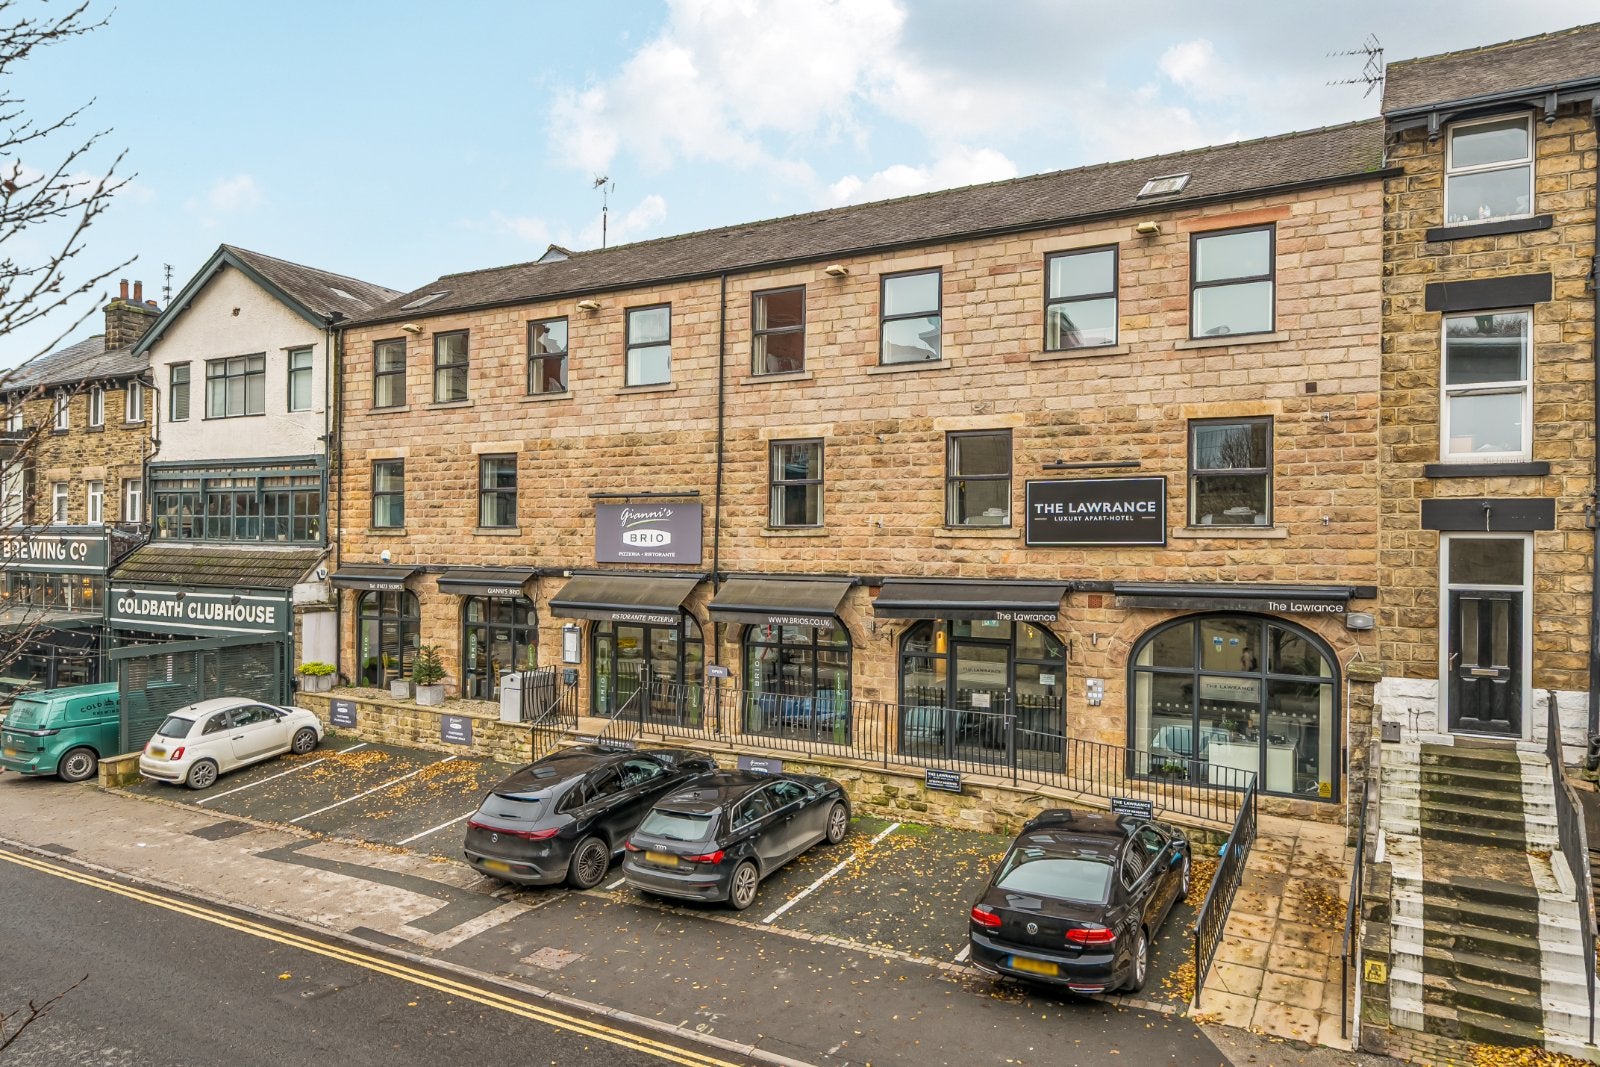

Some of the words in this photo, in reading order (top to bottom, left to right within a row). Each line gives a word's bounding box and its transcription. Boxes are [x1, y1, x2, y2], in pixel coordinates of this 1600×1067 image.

[1034, 503, 1063, 514] THE
[1068, 501, 1156, 513] LAWRANCE
[620, 507, 674, 527] Gianni's
[630, 533, 664, 543] BRIO
[3, 540, 66, 560] BREWING
[117, 597, 183, 618] COLDBATH
[187, 602, 275, 624] CLUBHOUSE
[1268, 601, 1287, 611] The
[1290, 602, 1344, 612] Lawrance
[611, 613, 647, 621] RISTORANTE
[647, 614, 674, 623] PIZZERIA
[995, 611, 1011, 620] The
[1013, 612, 1056, 621] Lawrance
[80, 702, 103, 713] COLD
